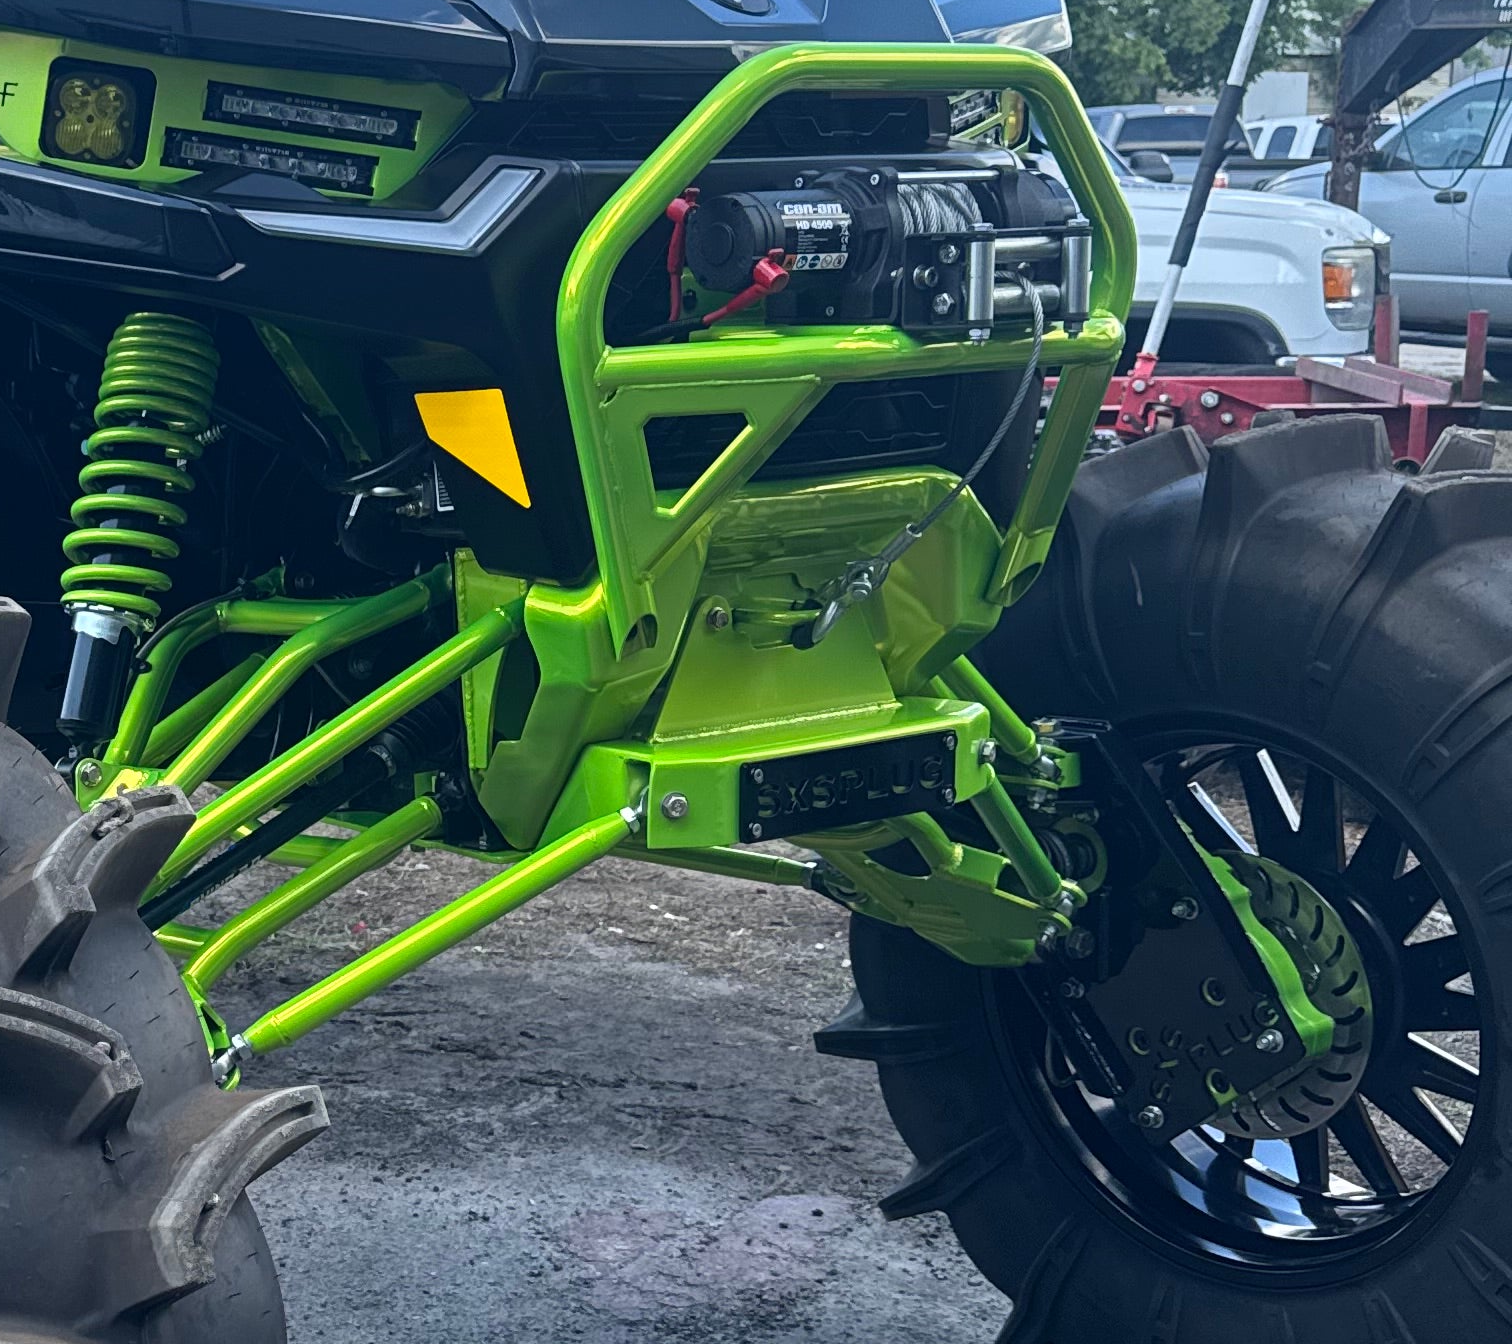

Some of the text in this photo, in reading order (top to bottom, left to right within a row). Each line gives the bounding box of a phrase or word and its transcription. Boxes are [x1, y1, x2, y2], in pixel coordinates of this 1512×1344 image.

[796, 219, 833, 230] HD 4500
[756, 755, 944, 818] SXSPLUG
